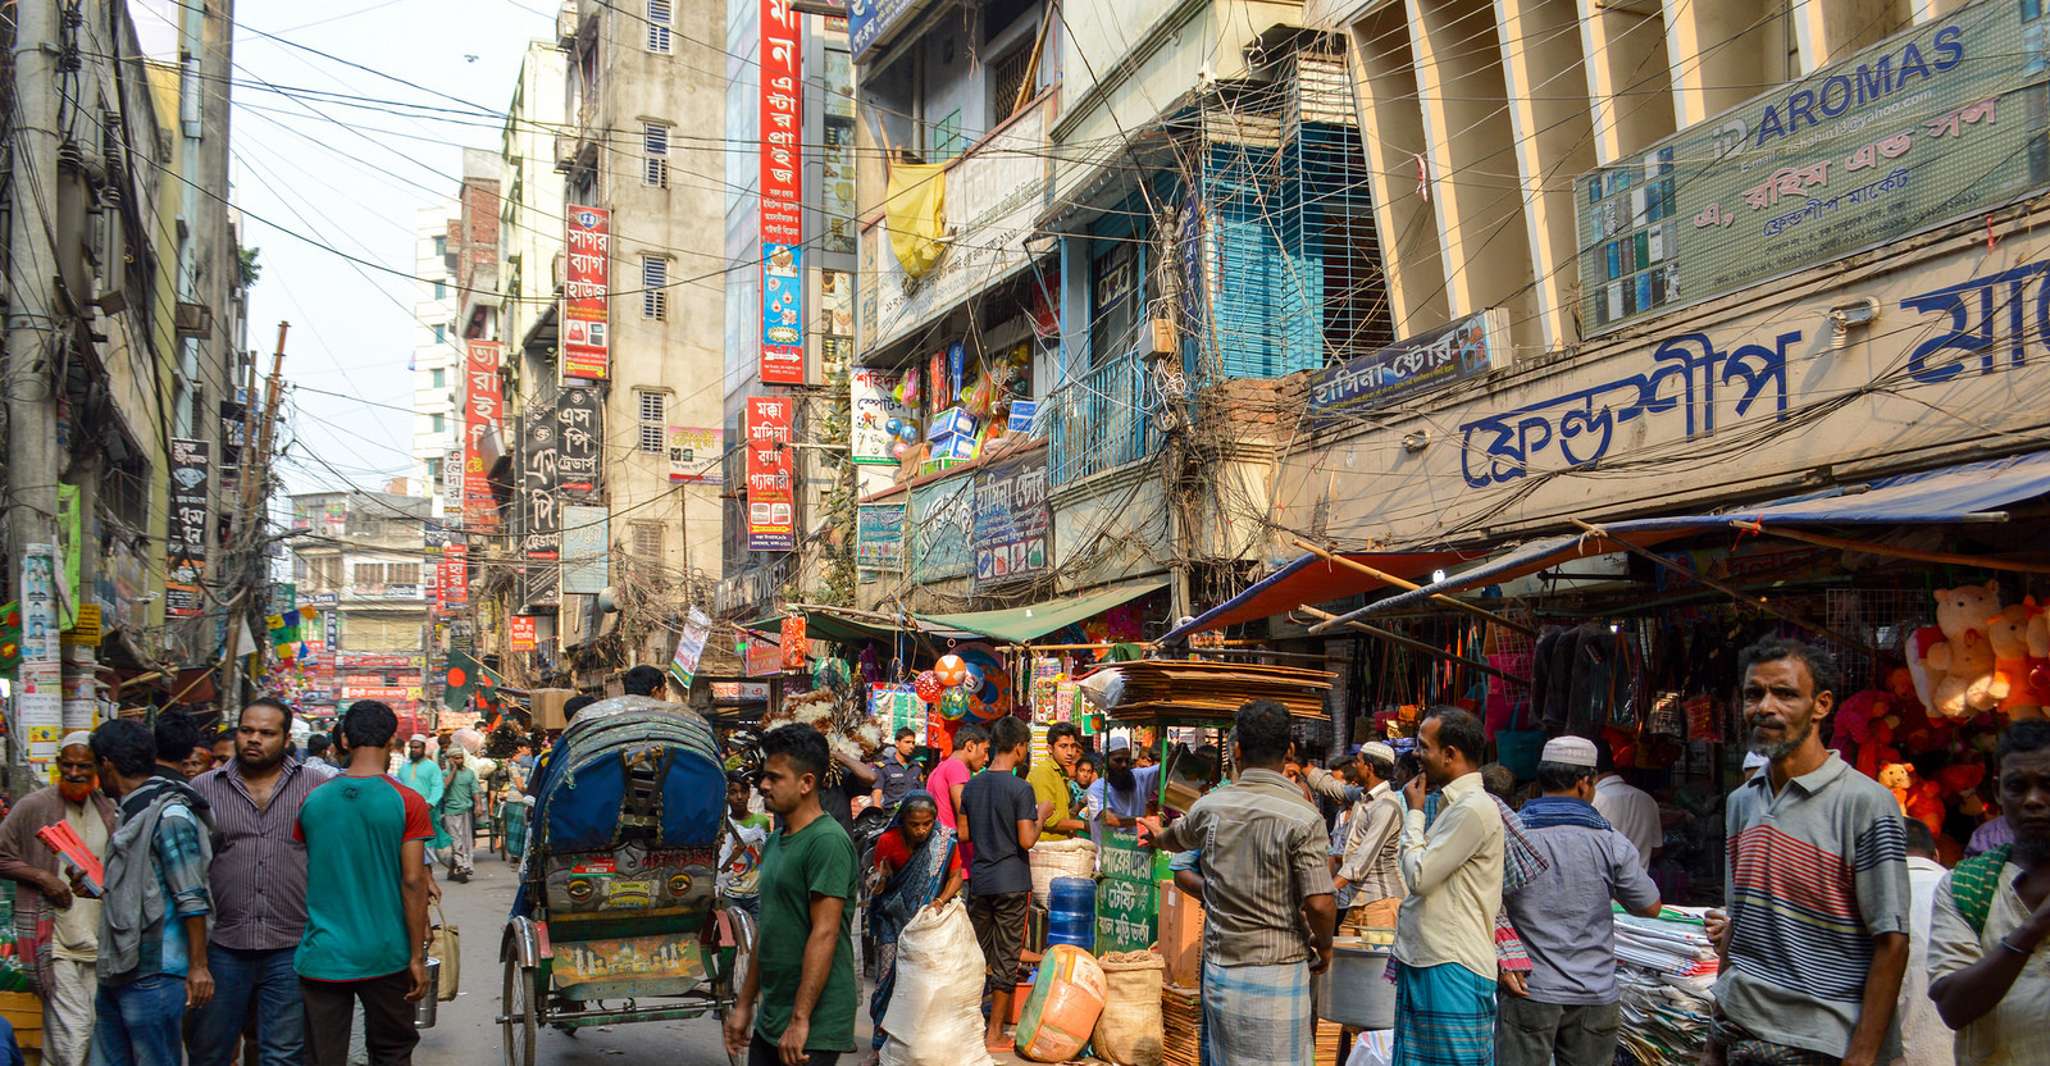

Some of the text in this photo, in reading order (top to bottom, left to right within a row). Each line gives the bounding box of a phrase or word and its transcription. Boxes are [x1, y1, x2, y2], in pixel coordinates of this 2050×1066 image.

[1754, 25, 1965, 149] AROMAS
[1743, 160, 1833, 211] রহিম
[1849, 167, 1911, 205] মার্কেট
[568, 228, 609, 252] সাগর
[570, 252, 605, 276] ব্যাগ
[1313, 361, 1387, 404] হাসিনা
[558, 407, 592, 427] এস
[756, 401, 783, 419] মক্কা
[563, 427, 591, 454] পি
[752, 420, 788, 443] মদিনা
[758, 449, 783, 466] ব্যাগ
[751, 468, 789, 491] গ্যালারী
[975, 472, 1013, 517] হাসিনা
[531, 487, 555, 529] পি
